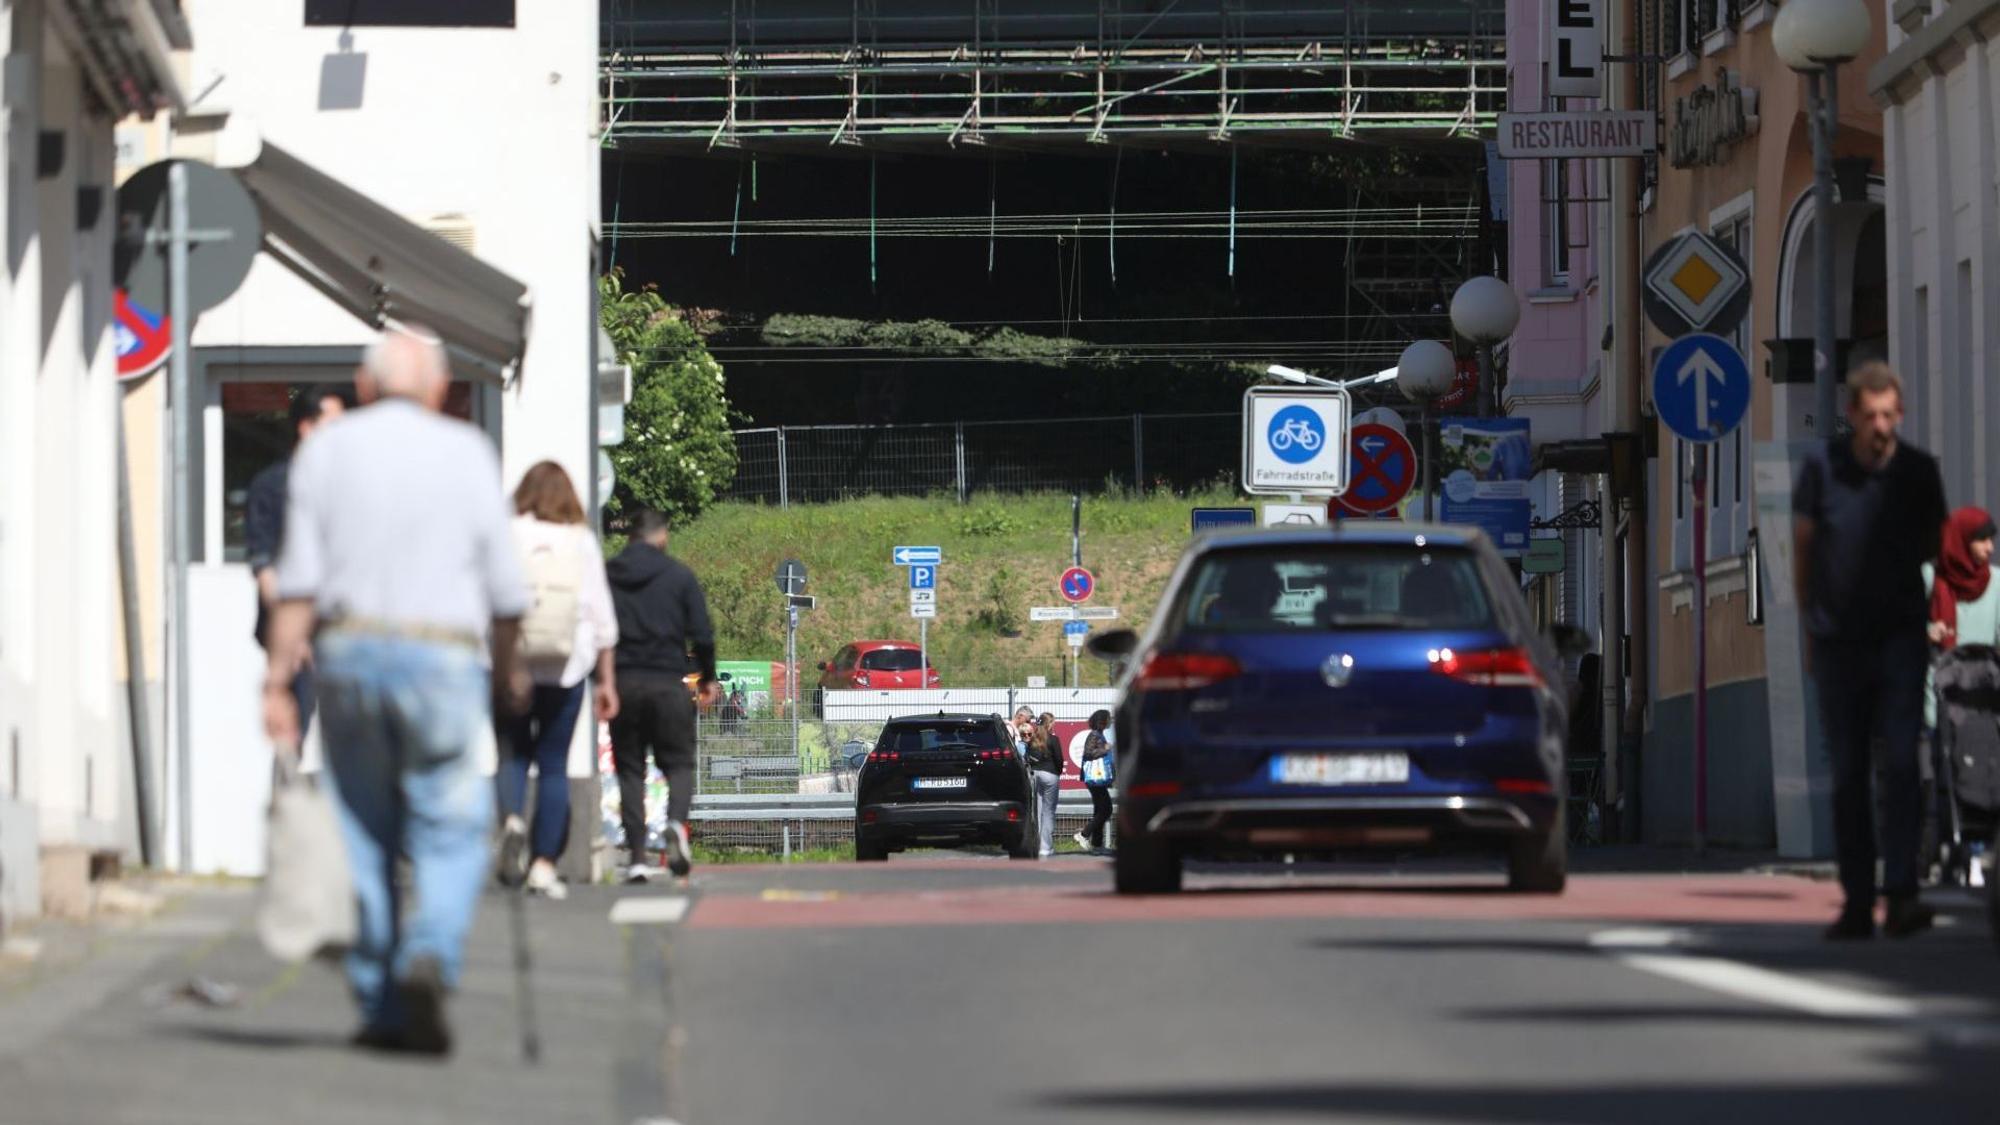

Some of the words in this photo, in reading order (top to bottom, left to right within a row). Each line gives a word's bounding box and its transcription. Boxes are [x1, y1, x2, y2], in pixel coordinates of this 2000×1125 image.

[1511, 119, 1645, 149] RESTAURANT
[1256, 469, 1335, 481] Fahrradstraße
[915, 567, 930, 587] P
[1059, 772, 1080, 782] mburg
